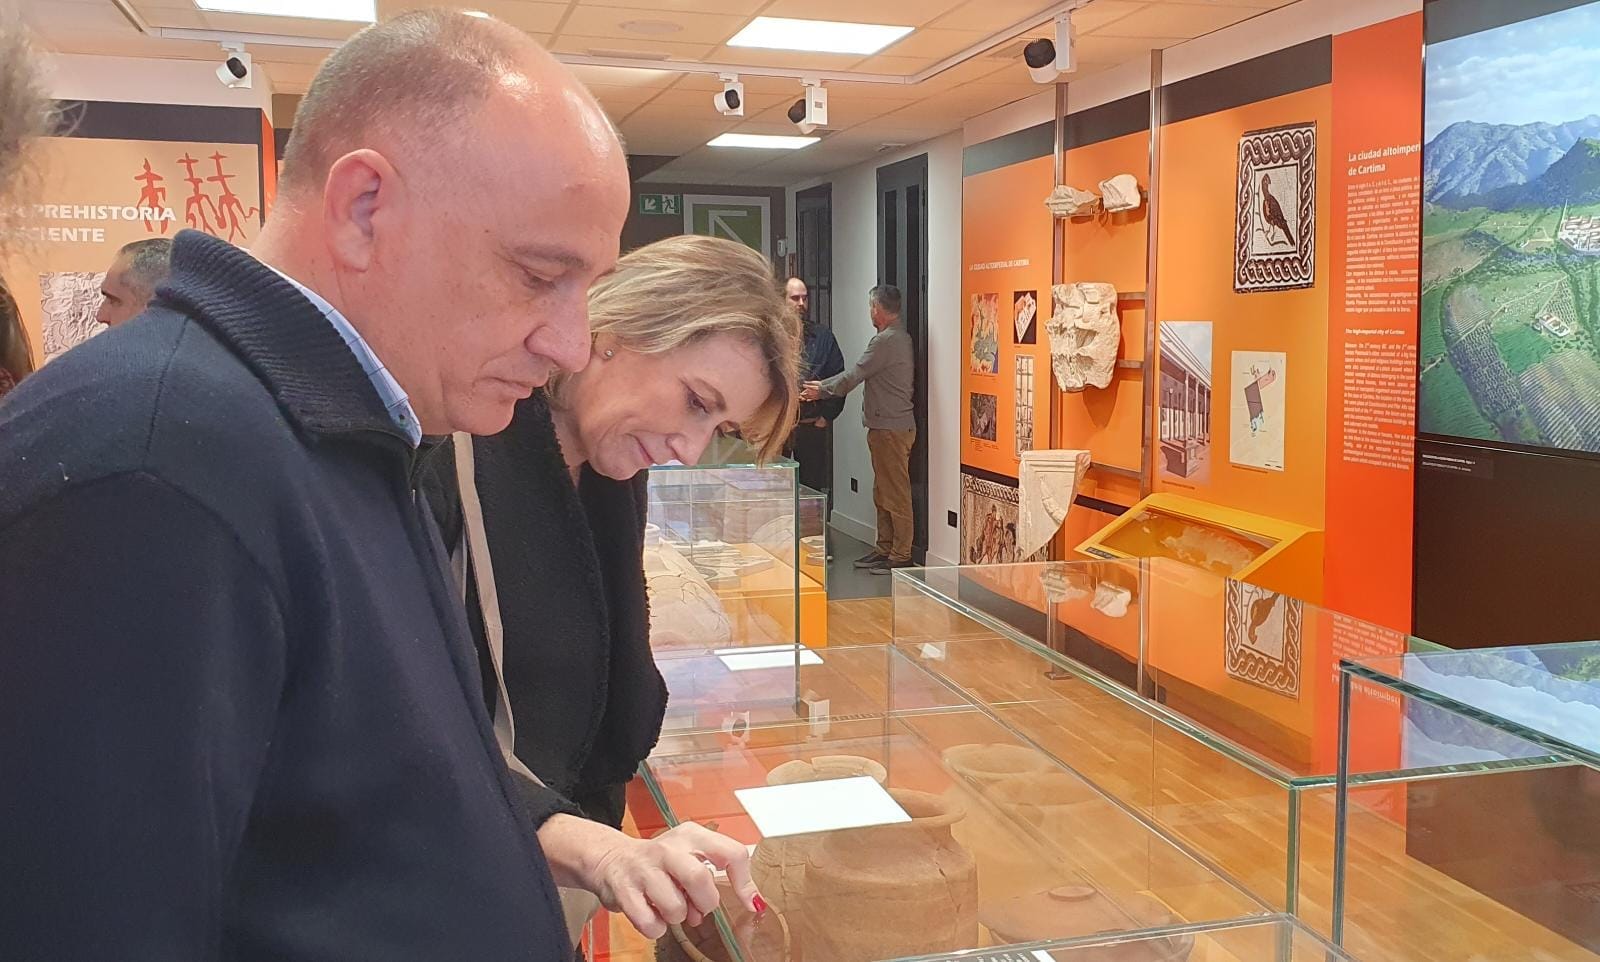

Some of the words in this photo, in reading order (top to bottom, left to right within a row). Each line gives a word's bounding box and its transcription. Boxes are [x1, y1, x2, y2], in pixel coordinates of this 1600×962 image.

[1348, 152, 1357, 162] La
[1358, 148, 1382, 160] ciudad
[1348, 167, 1357, 176] de
[1358, 163, 1386, 175] Cartima
